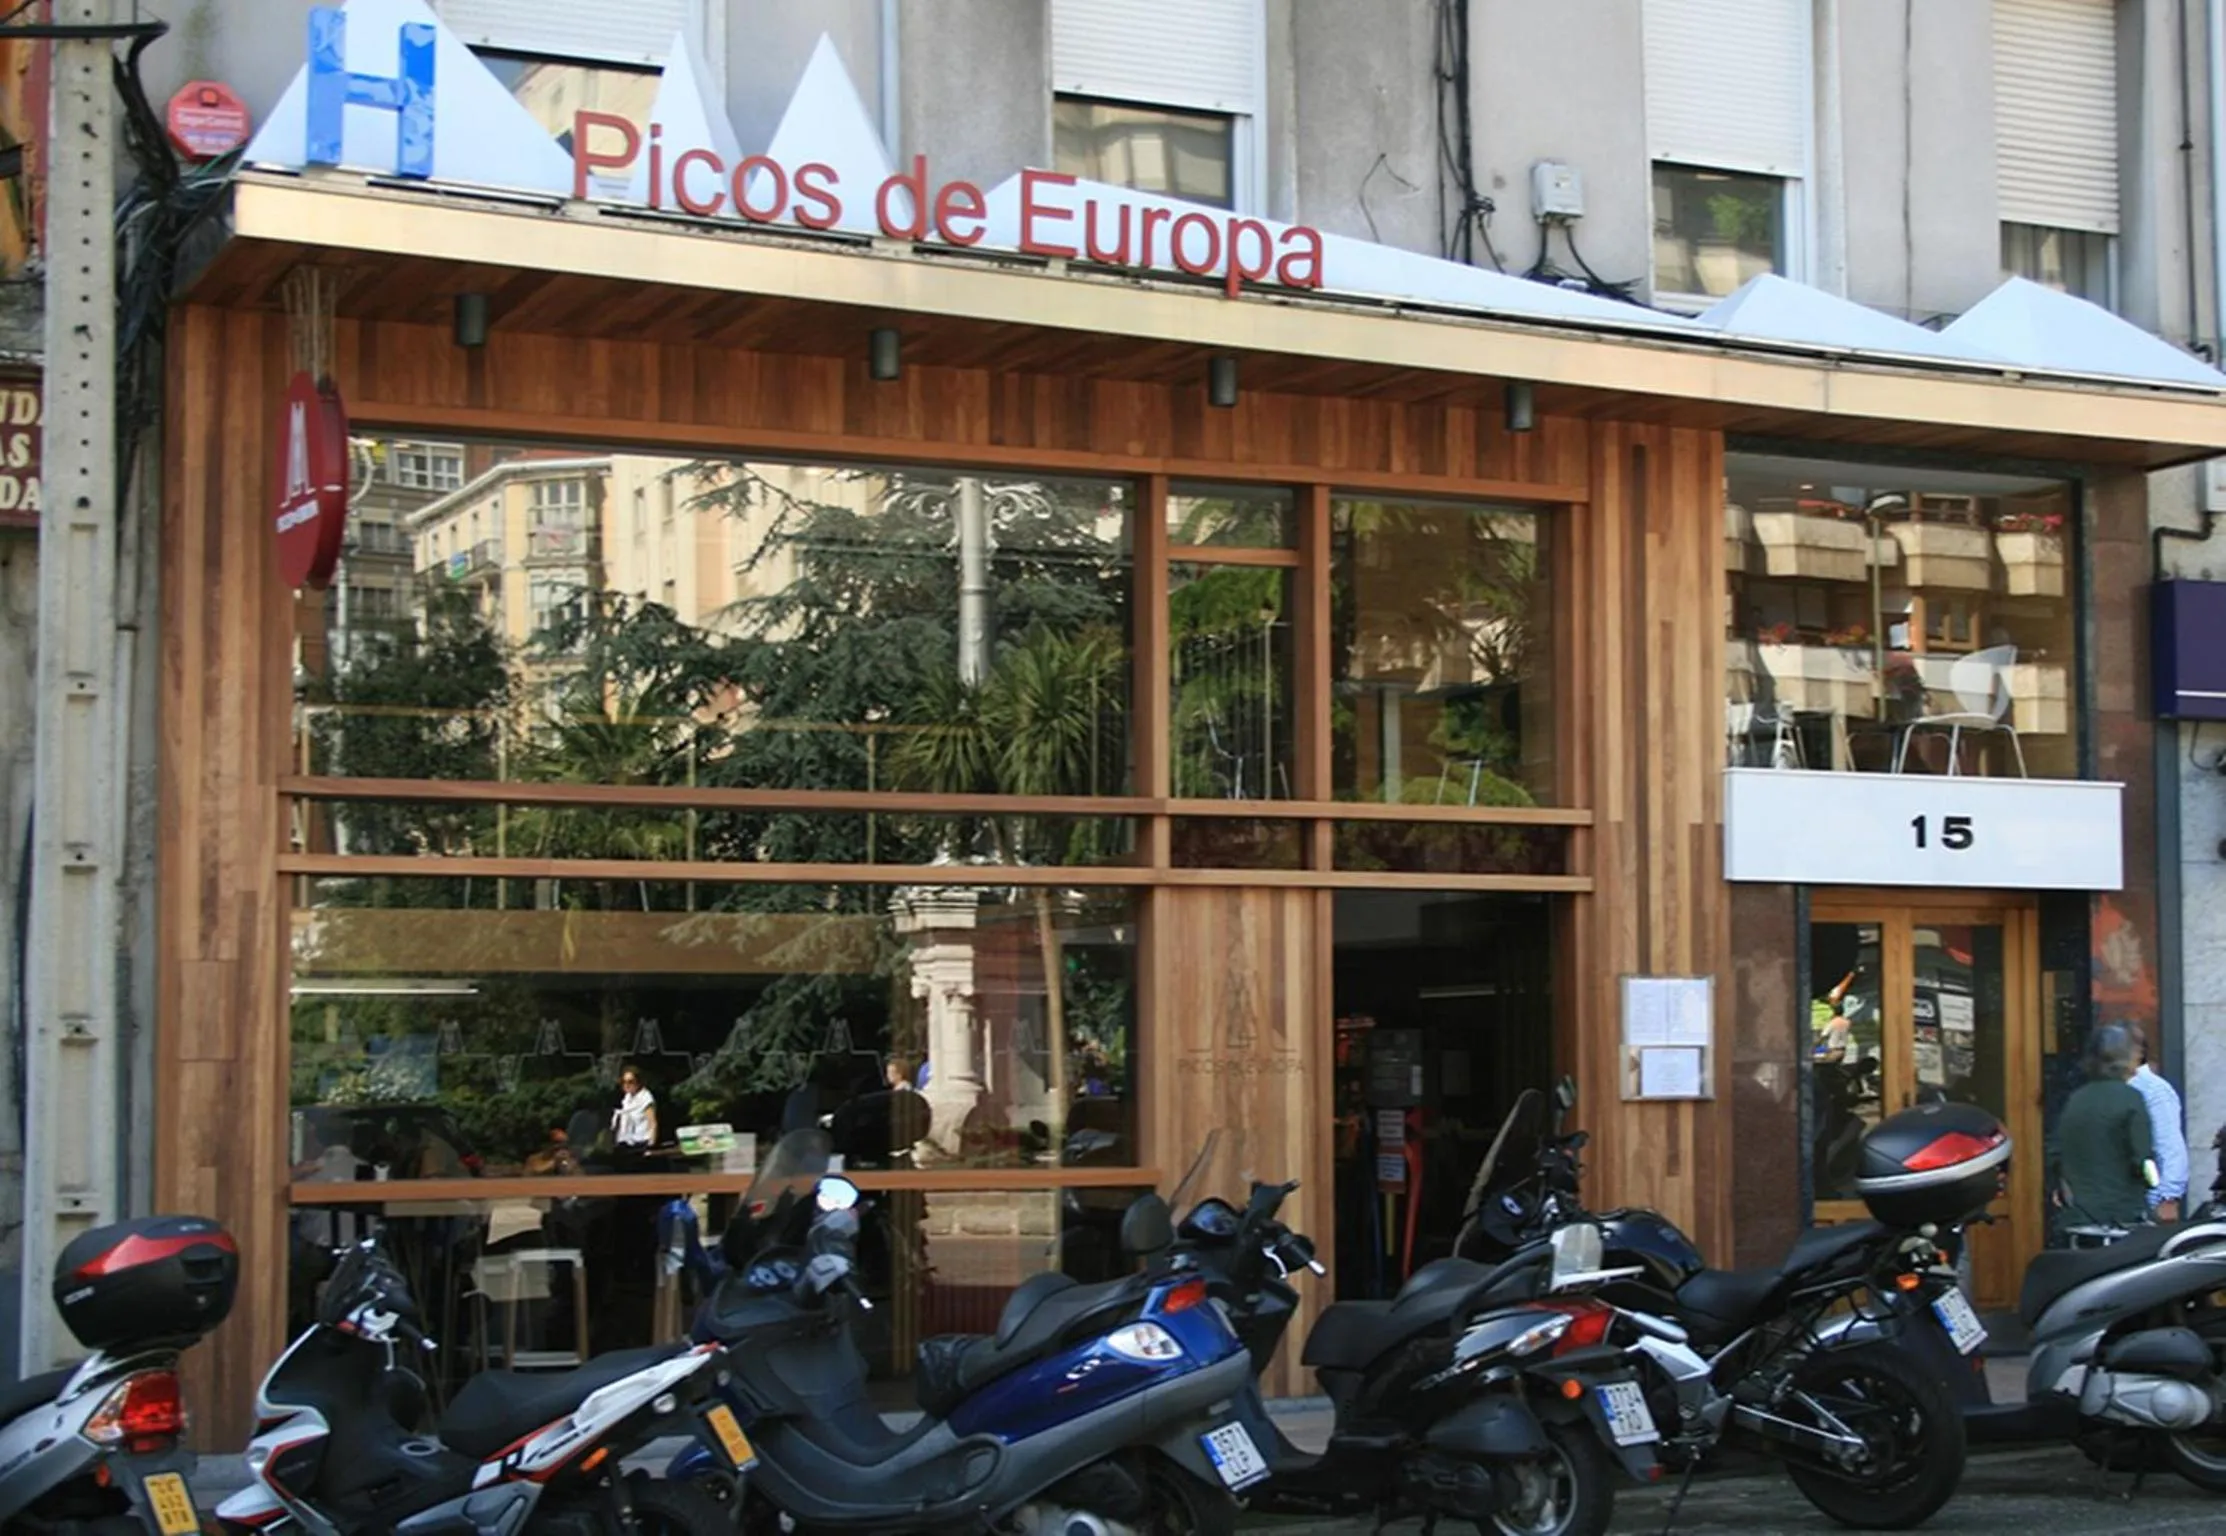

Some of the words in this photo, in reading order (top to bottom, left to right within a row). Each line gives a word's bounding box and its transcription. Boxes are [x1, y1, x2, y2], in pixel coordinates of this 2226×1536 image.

[307, 6, 436, 181] H
[572, 110, 843, 231] Picos
[875, 154, 987, 247] de
[1020, 166, 1323, 299] Europa
[1911, 814, 1974, 850] 15
